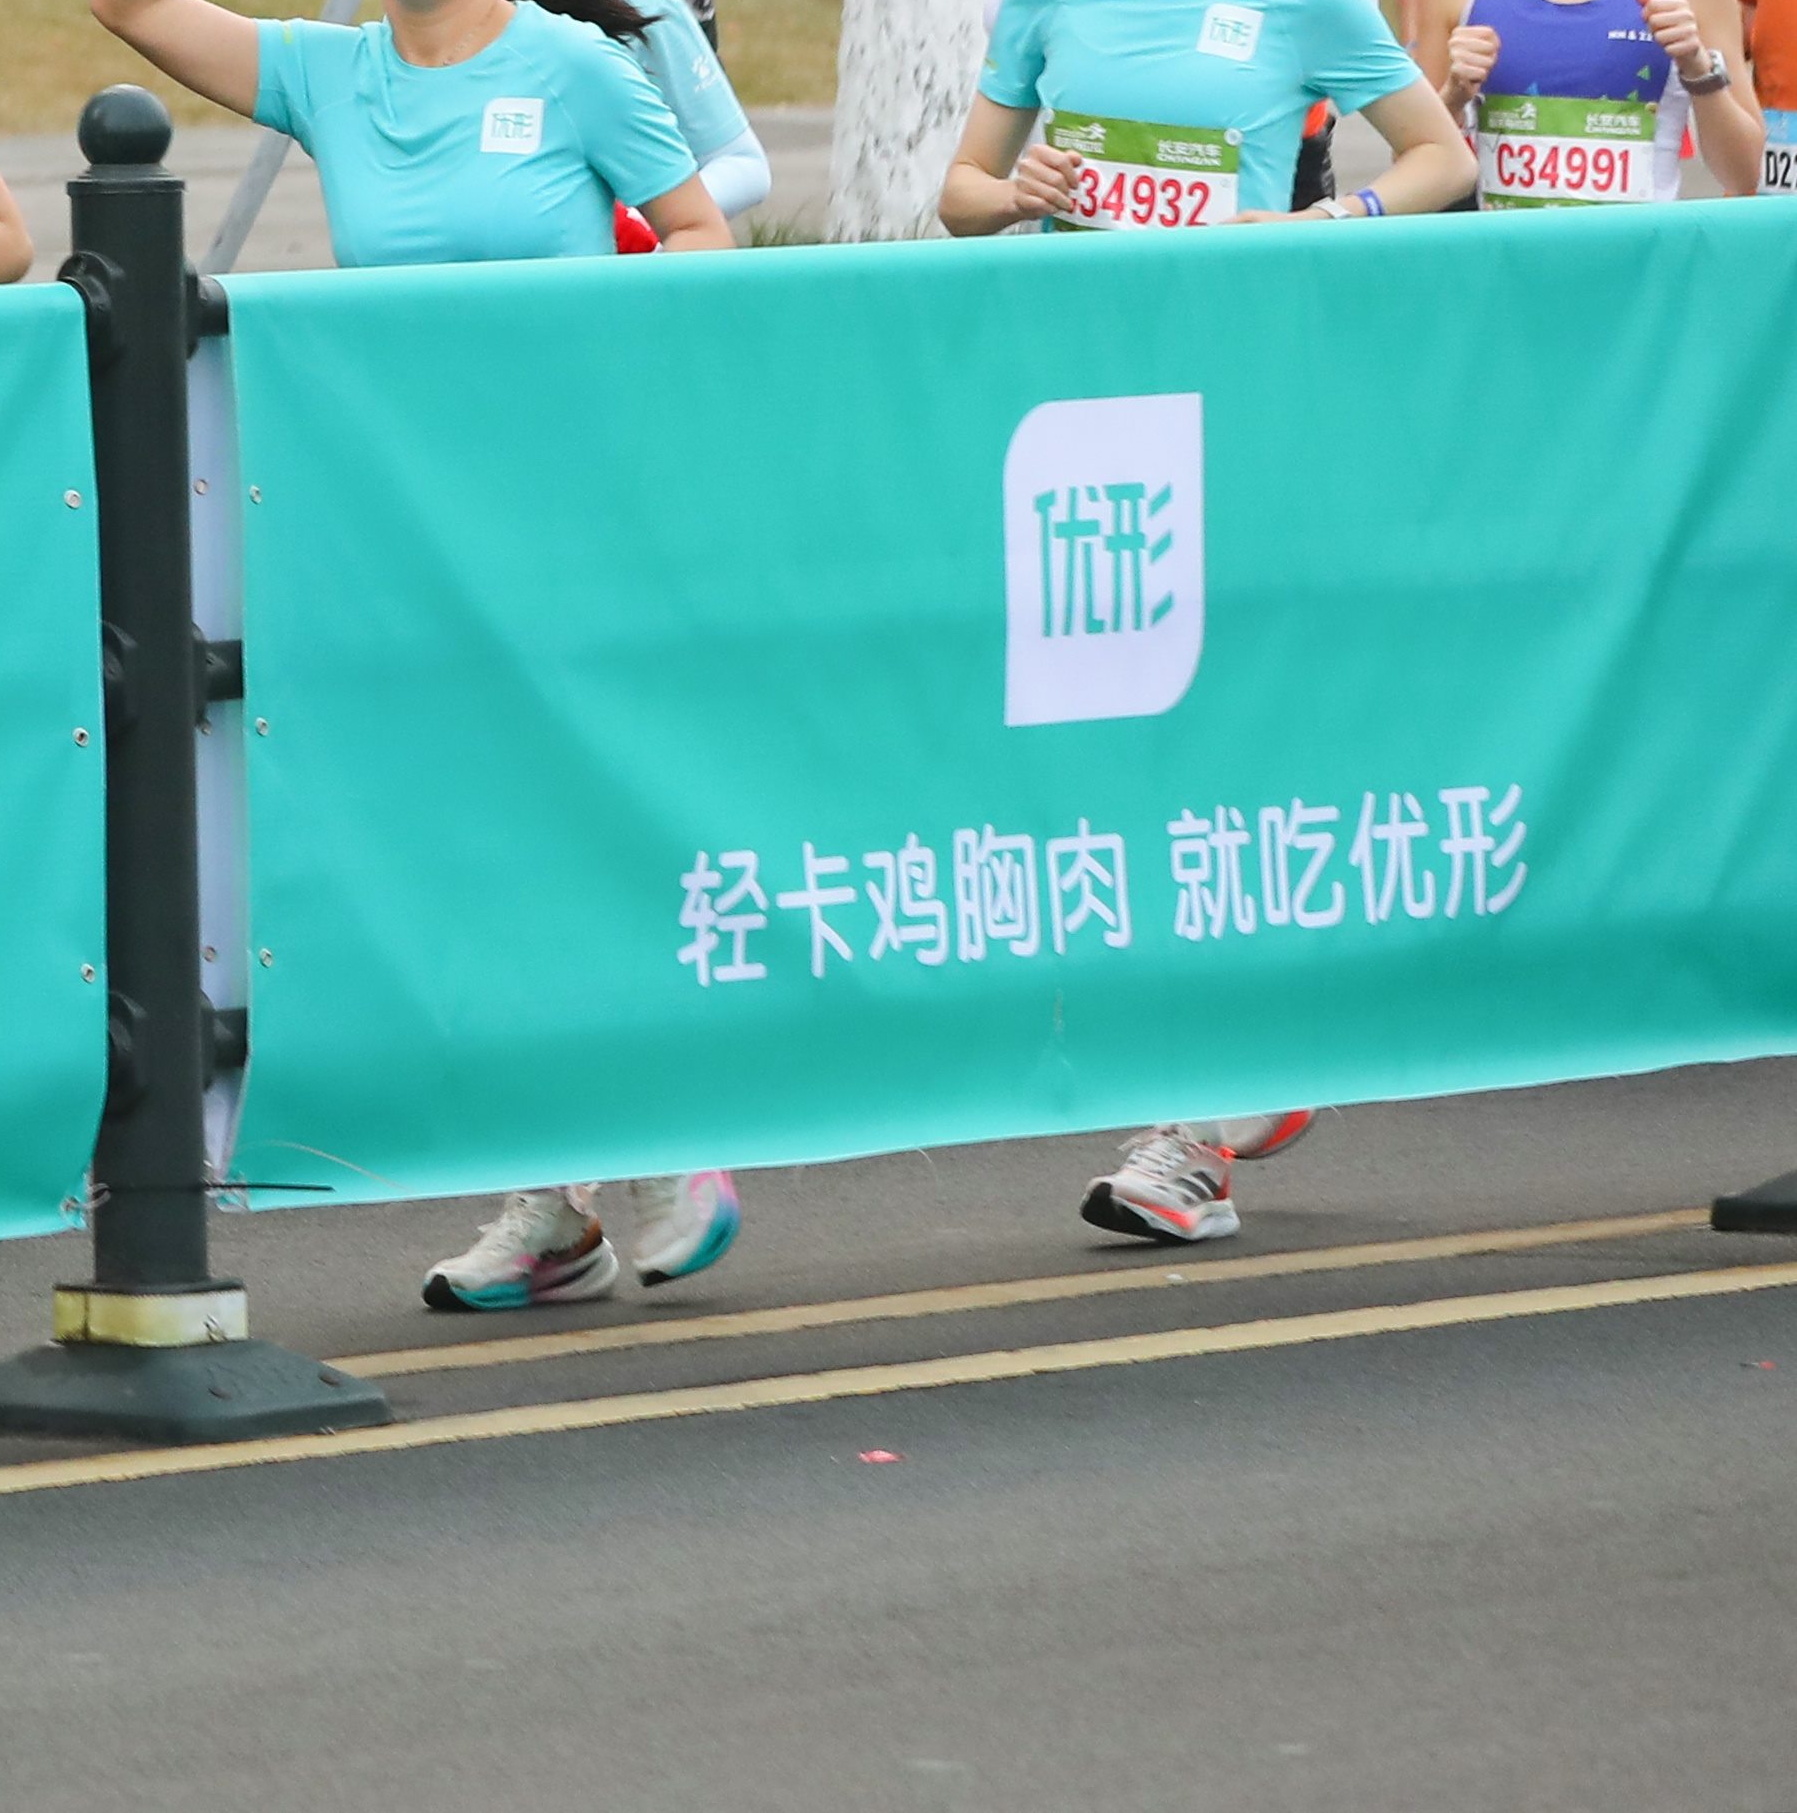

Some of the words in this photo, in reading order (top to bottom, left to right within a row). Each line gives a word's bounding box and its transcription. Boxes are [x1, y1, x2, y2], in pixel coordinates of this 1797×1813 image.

[1069, 168, 1211, 227] 34932
[1497, 142, 1630, 194] C34991
[1765, 150, 1797, 188] D2
[1035, 481, 1174, 639] 优形
[677, 816, 1133, 987] 轻卡鸡胸肉
[1167, 783, 1528, 942] 就吃优形
